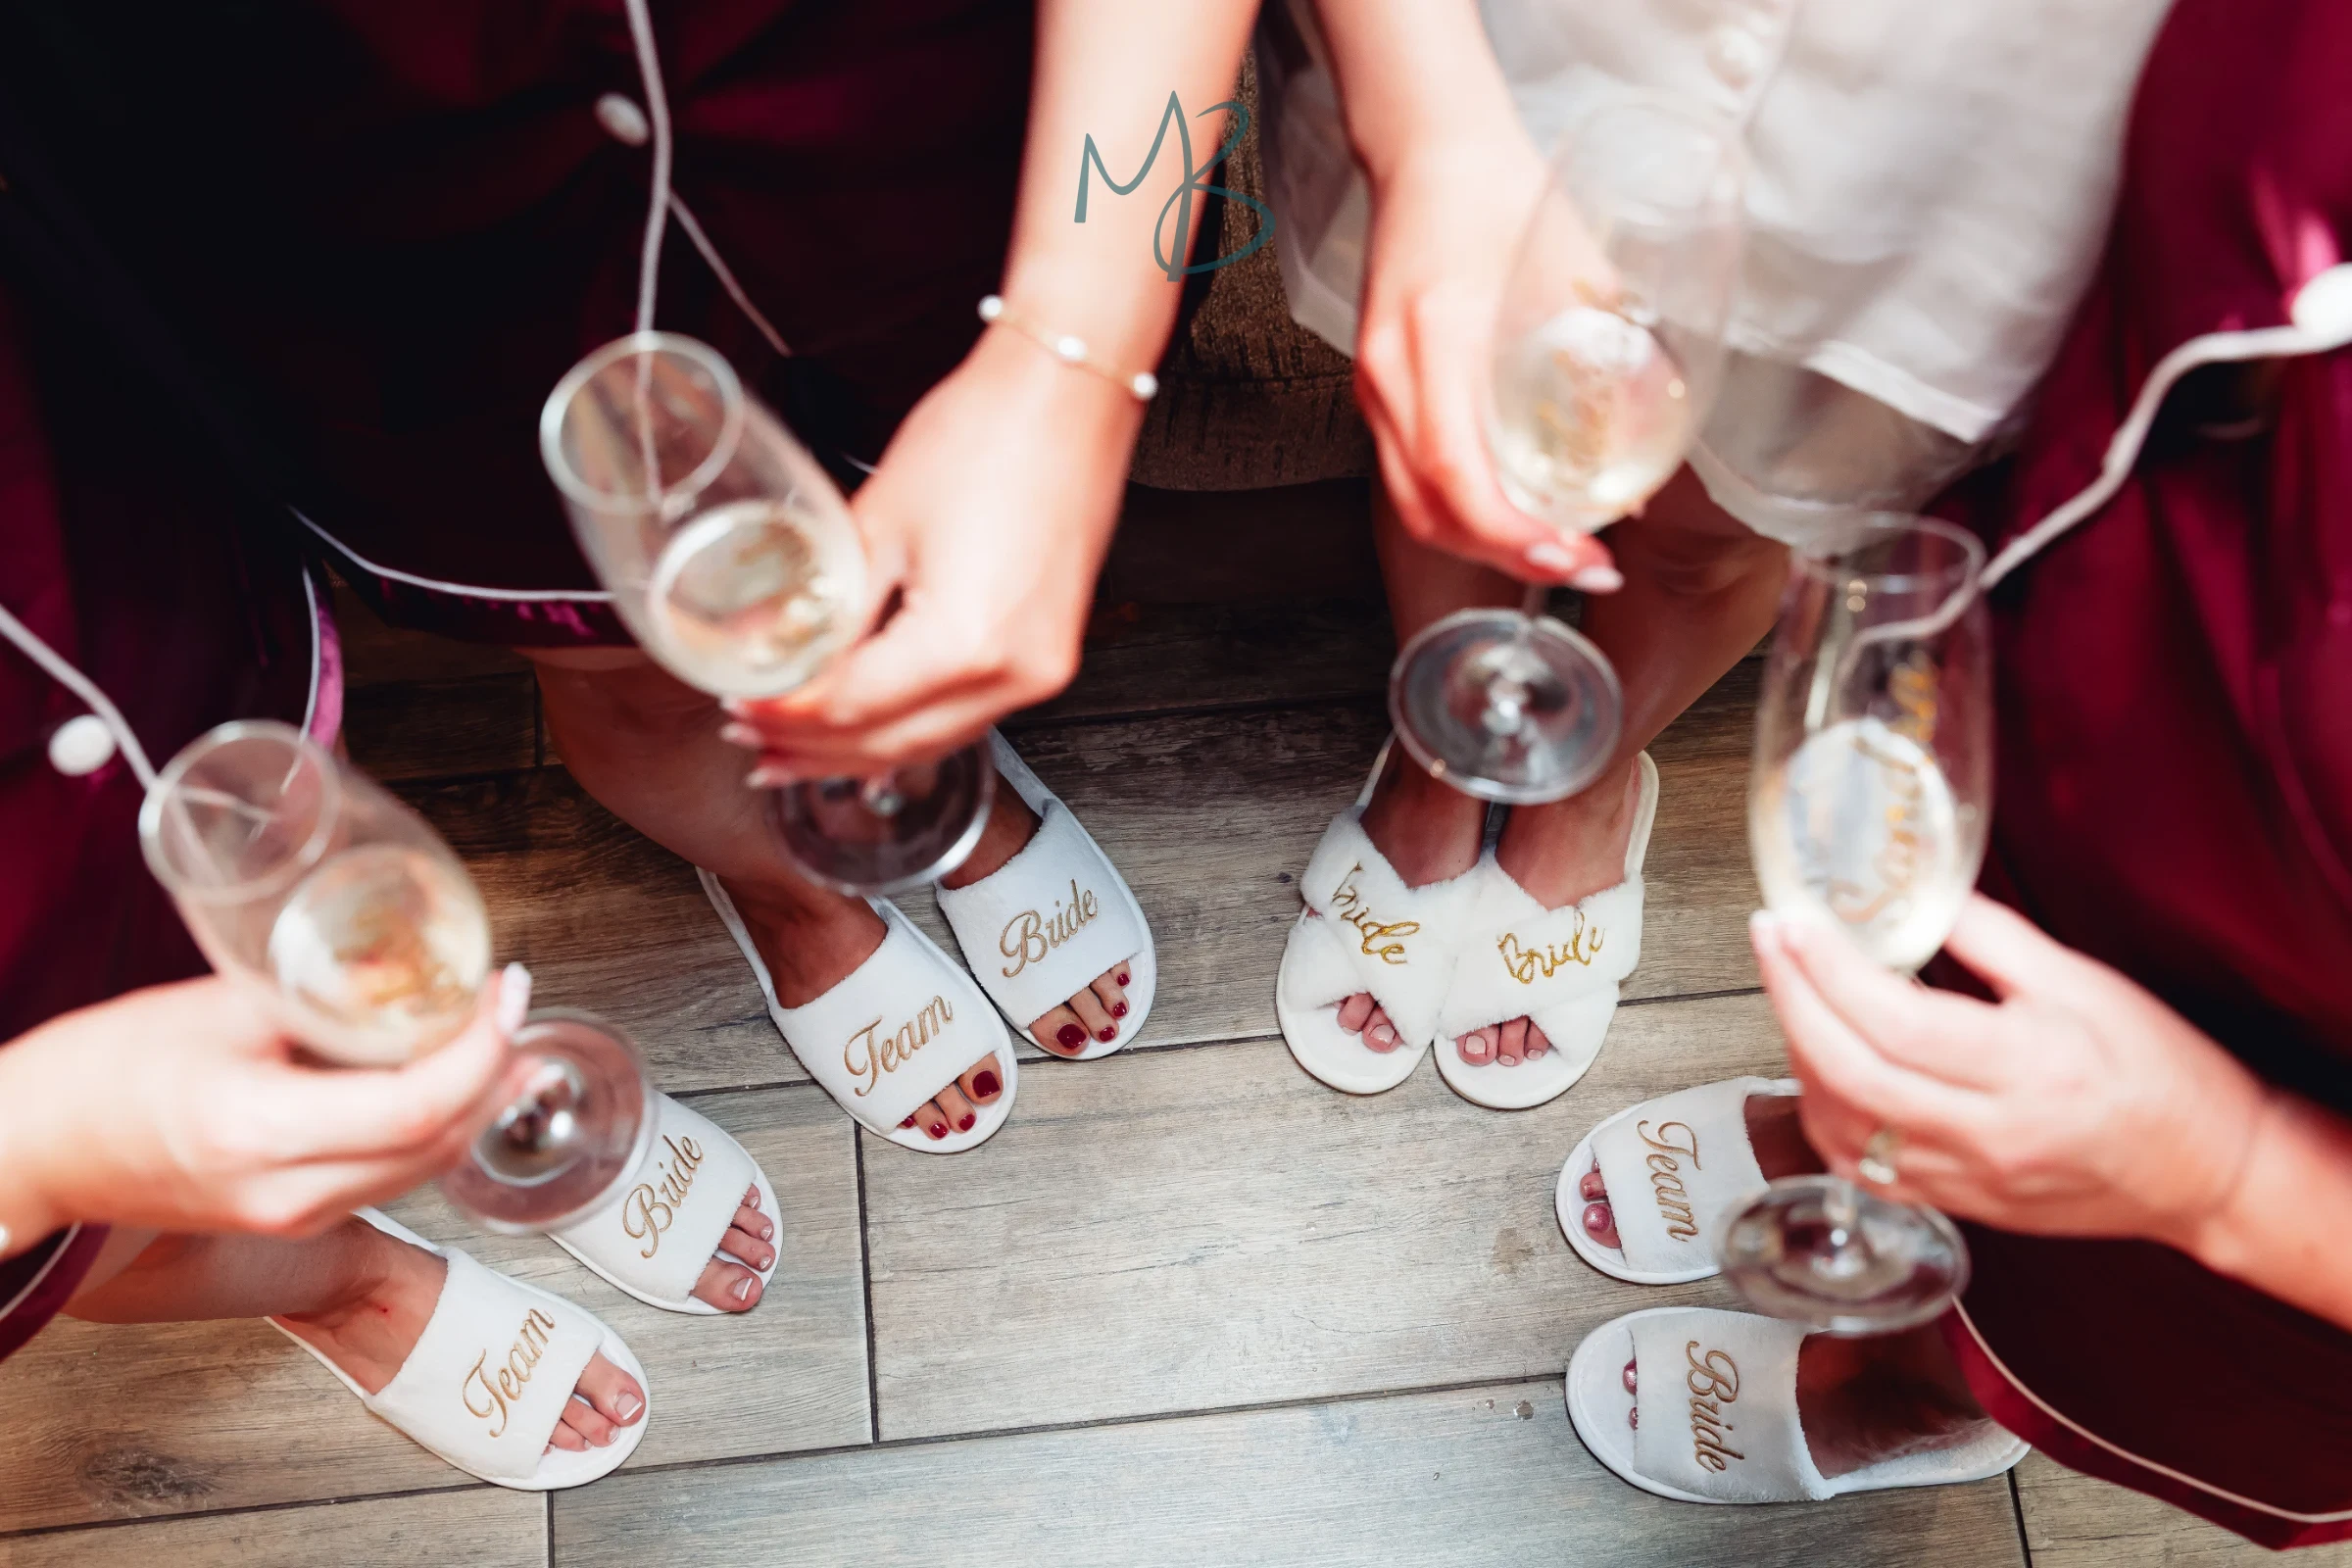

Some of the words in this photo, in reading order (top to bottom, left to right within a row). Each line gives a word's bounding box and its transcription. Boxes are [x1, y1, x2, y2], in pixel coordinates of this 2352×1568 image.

[1000, 879, 1099, 978] Bride
[844, 995, 953, 1097] Team
[622, 1134, 704, 1259] Bride
[1637, 1119, 1702, 1243] Team
[462, 1308, 556, 1438] Team
[1686, 1340, 1745, 1474] Bride
